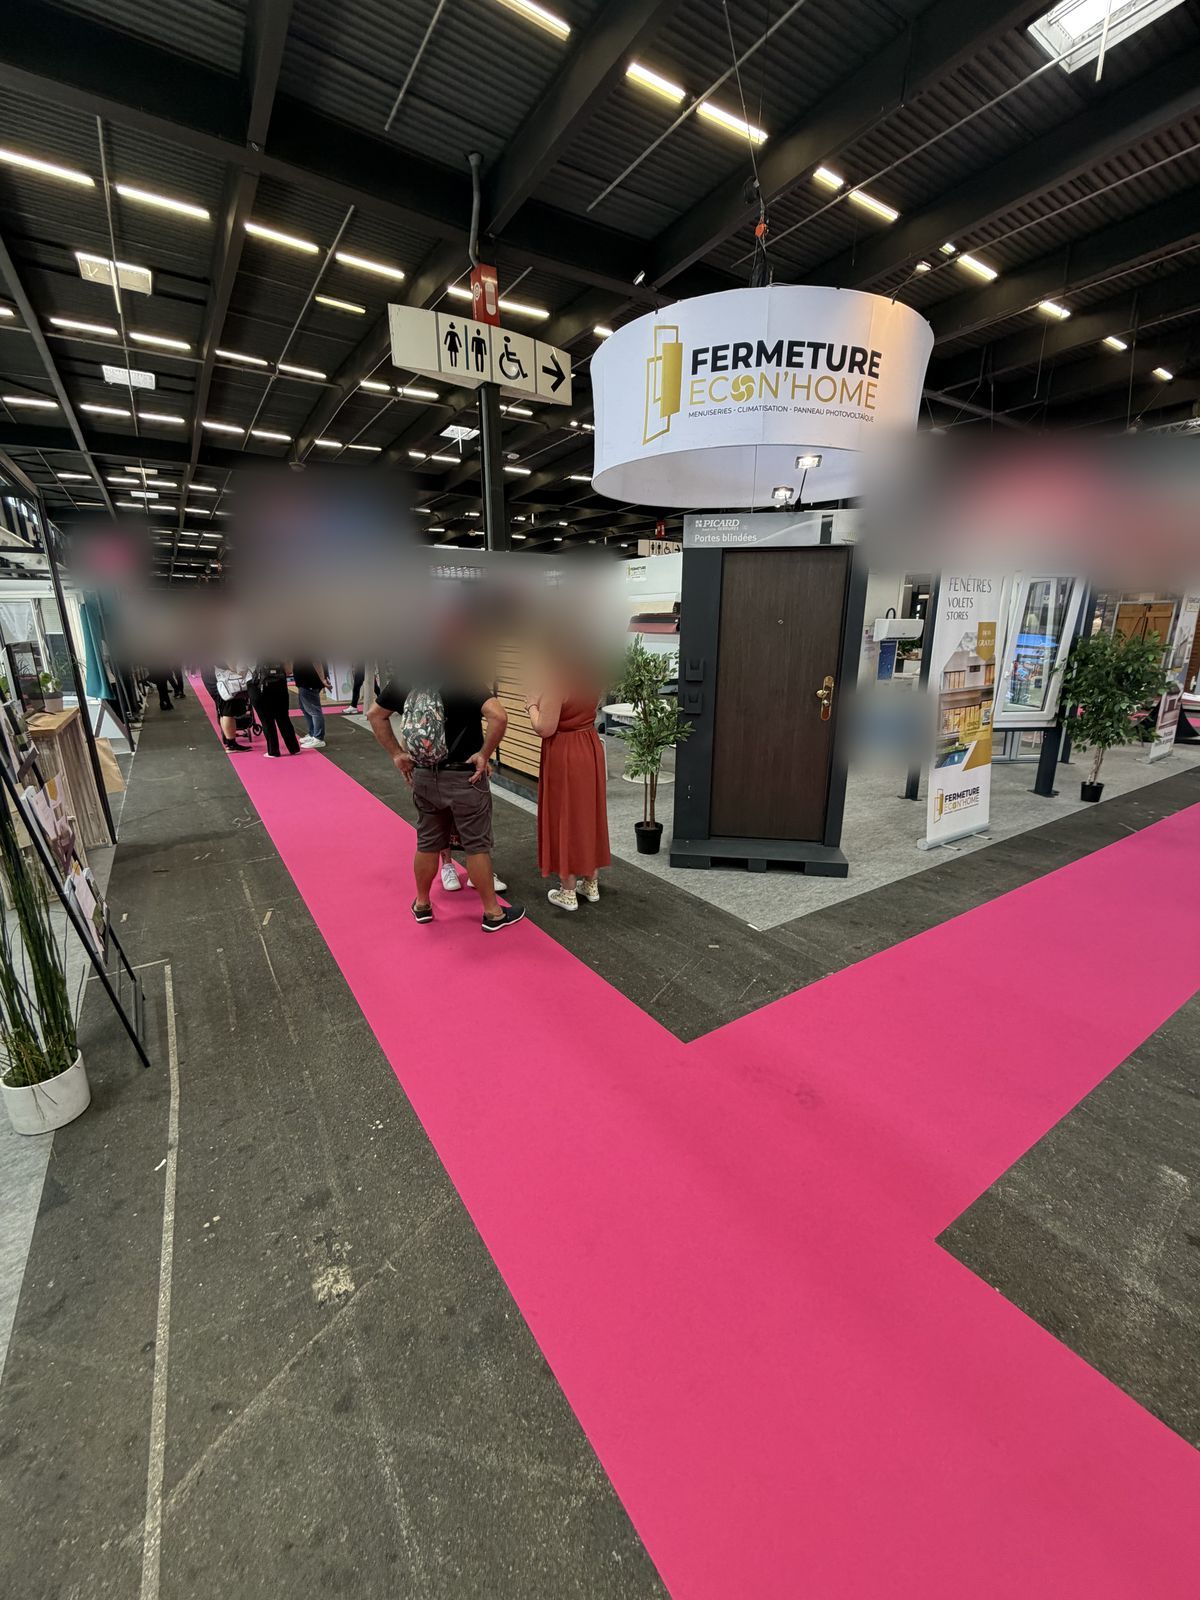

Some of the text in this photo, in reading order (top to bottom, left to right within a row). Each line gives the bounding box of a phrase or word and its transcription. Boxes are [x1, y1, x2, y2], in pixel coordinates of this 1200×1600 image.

[691, 339, 882, 380] FERMETURE
[688, 407, 732, 418] MENUISERIES
[737, 405, 788, 413] CLIMATISATION
[793, 406, 824, 415] PANNEAU
[825, 408, 874, 423] PHOTOVOLTAÏQUE
[703, 519, 740, 528] PICARD
[694, 532, 757, 543] Portes blindées
[947, 596, 974, 609] VOLETS
[946, 611, 969, 621] STORES
[944, 786, 980, 803] FERMETURE
